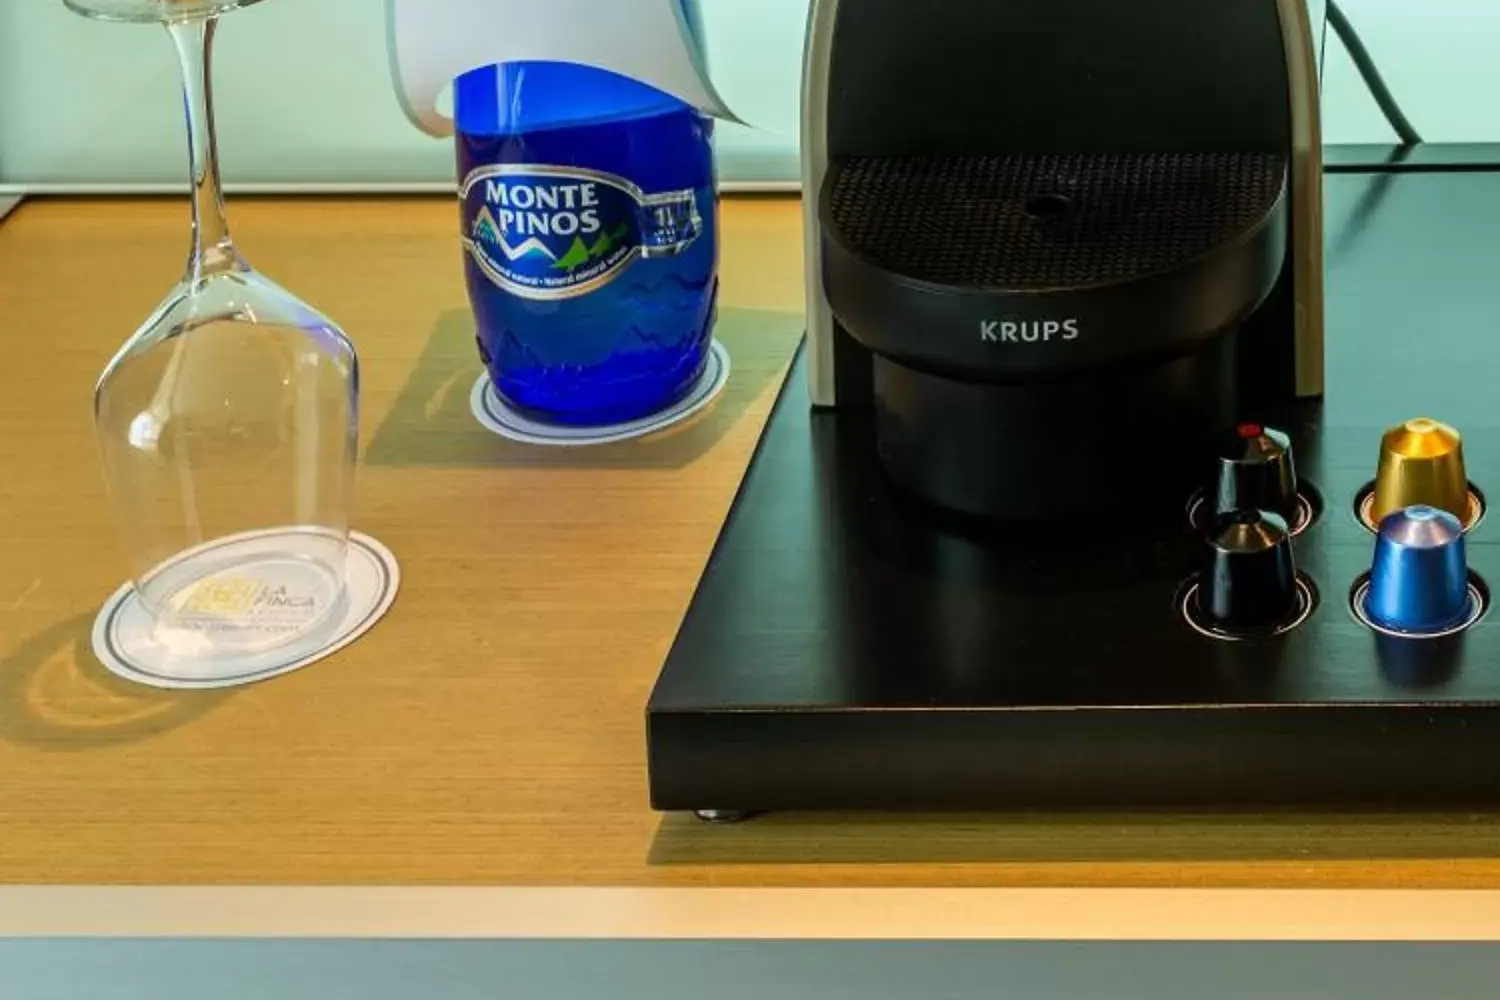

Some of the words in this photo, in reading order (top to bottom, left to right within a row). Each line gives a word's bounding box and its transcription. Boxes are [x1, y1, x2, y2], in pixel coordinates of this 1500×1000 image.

[485, 180, 600, 207] MONTE
[498, 209, 602, 236] PINOS
[980, 318, 1079, 343] KRUPS
